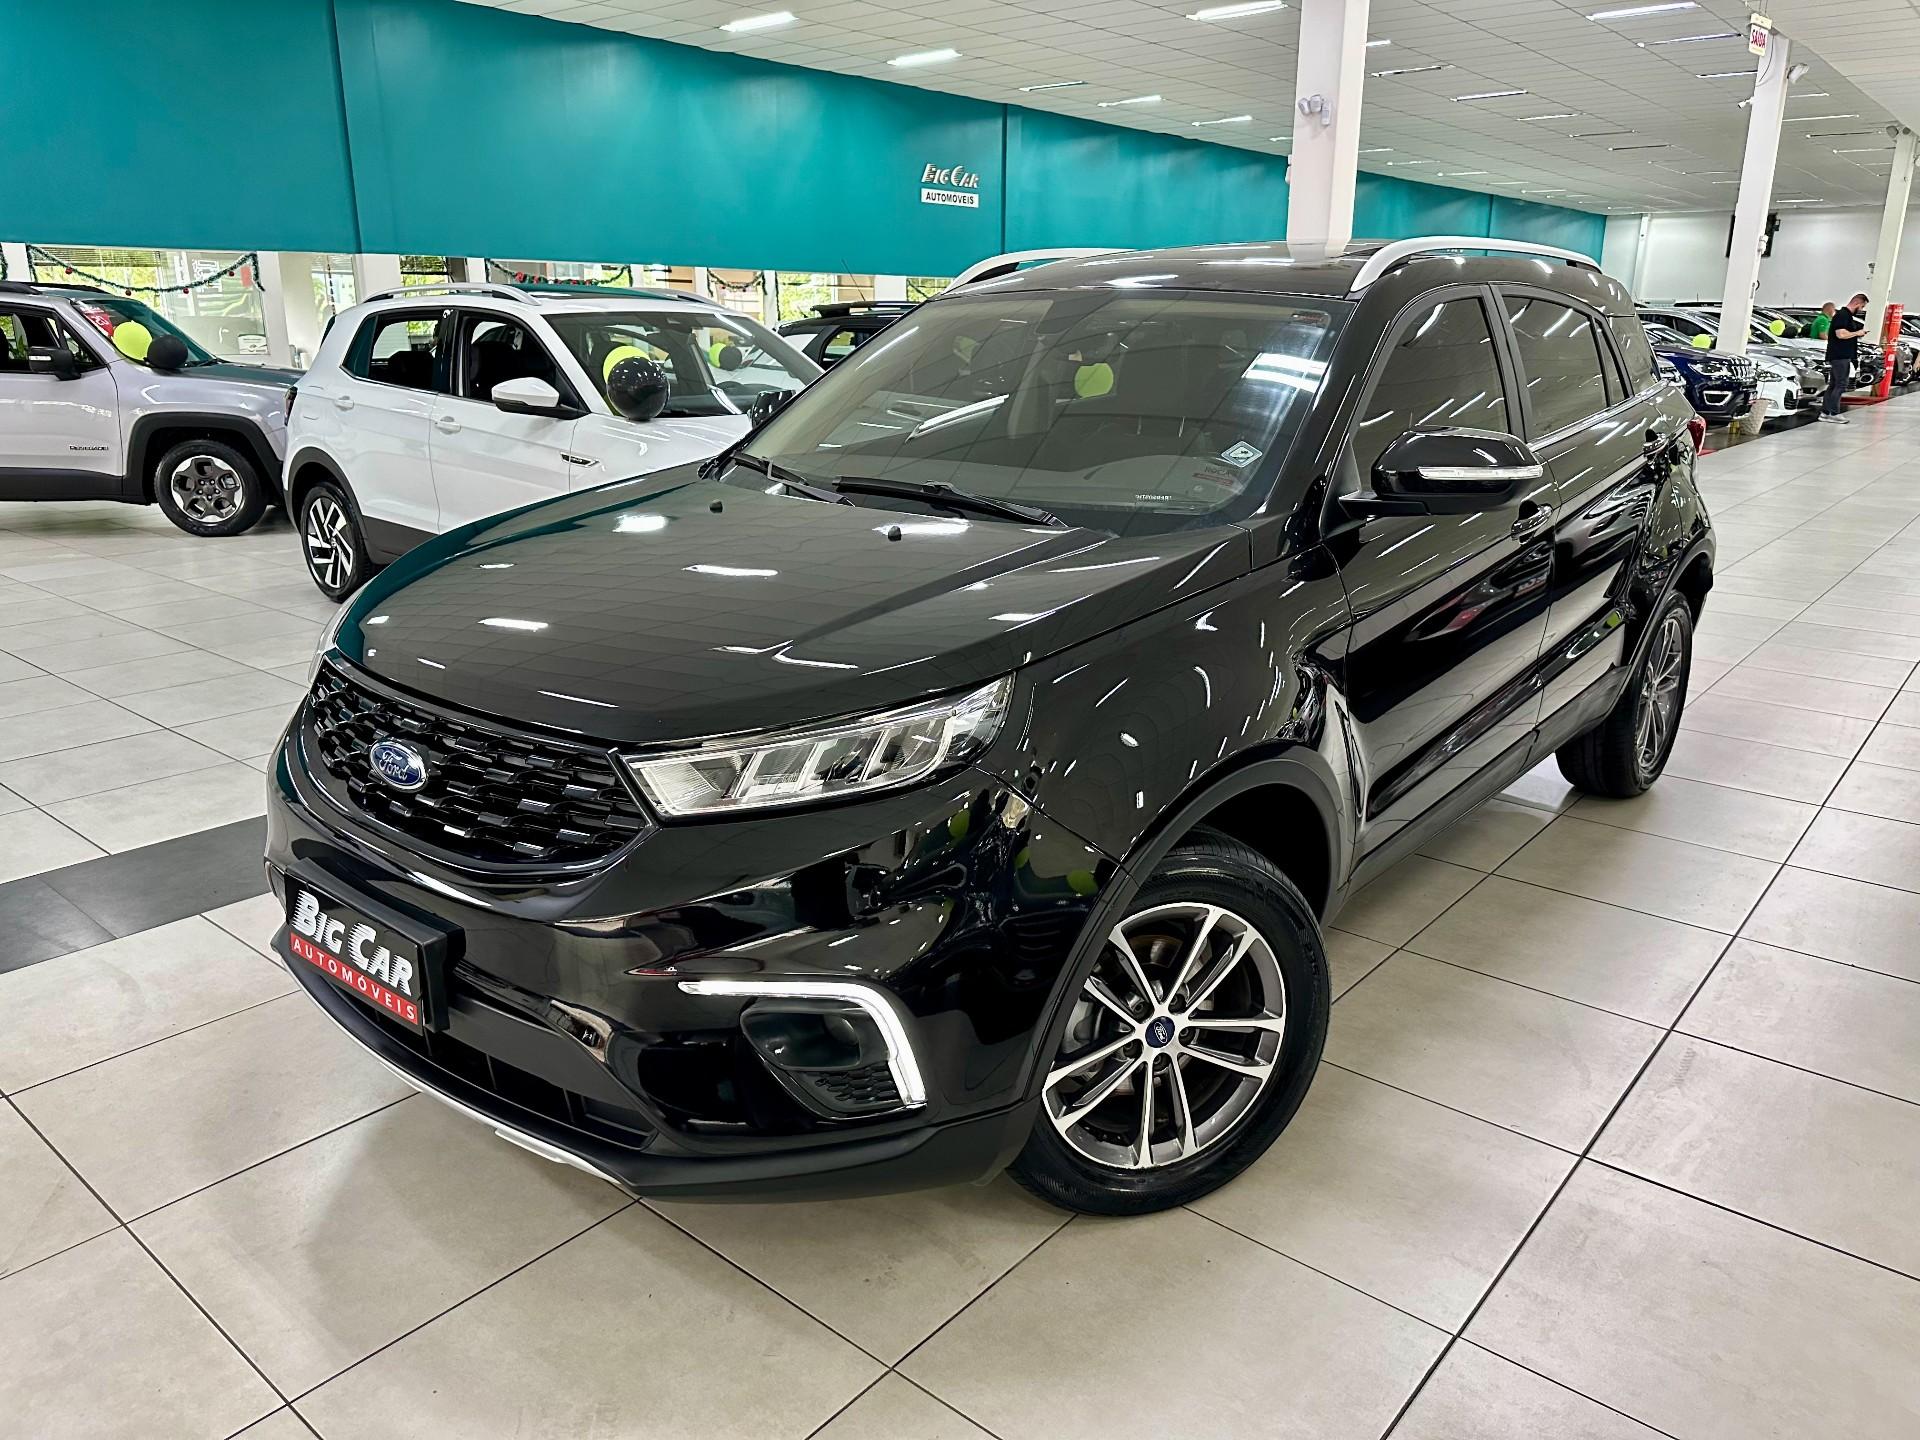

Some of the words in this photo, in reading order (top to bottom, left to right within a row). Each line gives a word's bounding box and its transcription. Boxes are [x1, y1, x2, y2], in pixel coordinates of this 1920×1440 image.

[950, 165, 979, 189] CAR
[379, 750, 409, 781] Ford
[291, 889, 346, 954] BIG
[348, 922, 413, 997] CAR
[293, 938, 416, 1020] AUTOMÓVEIS
